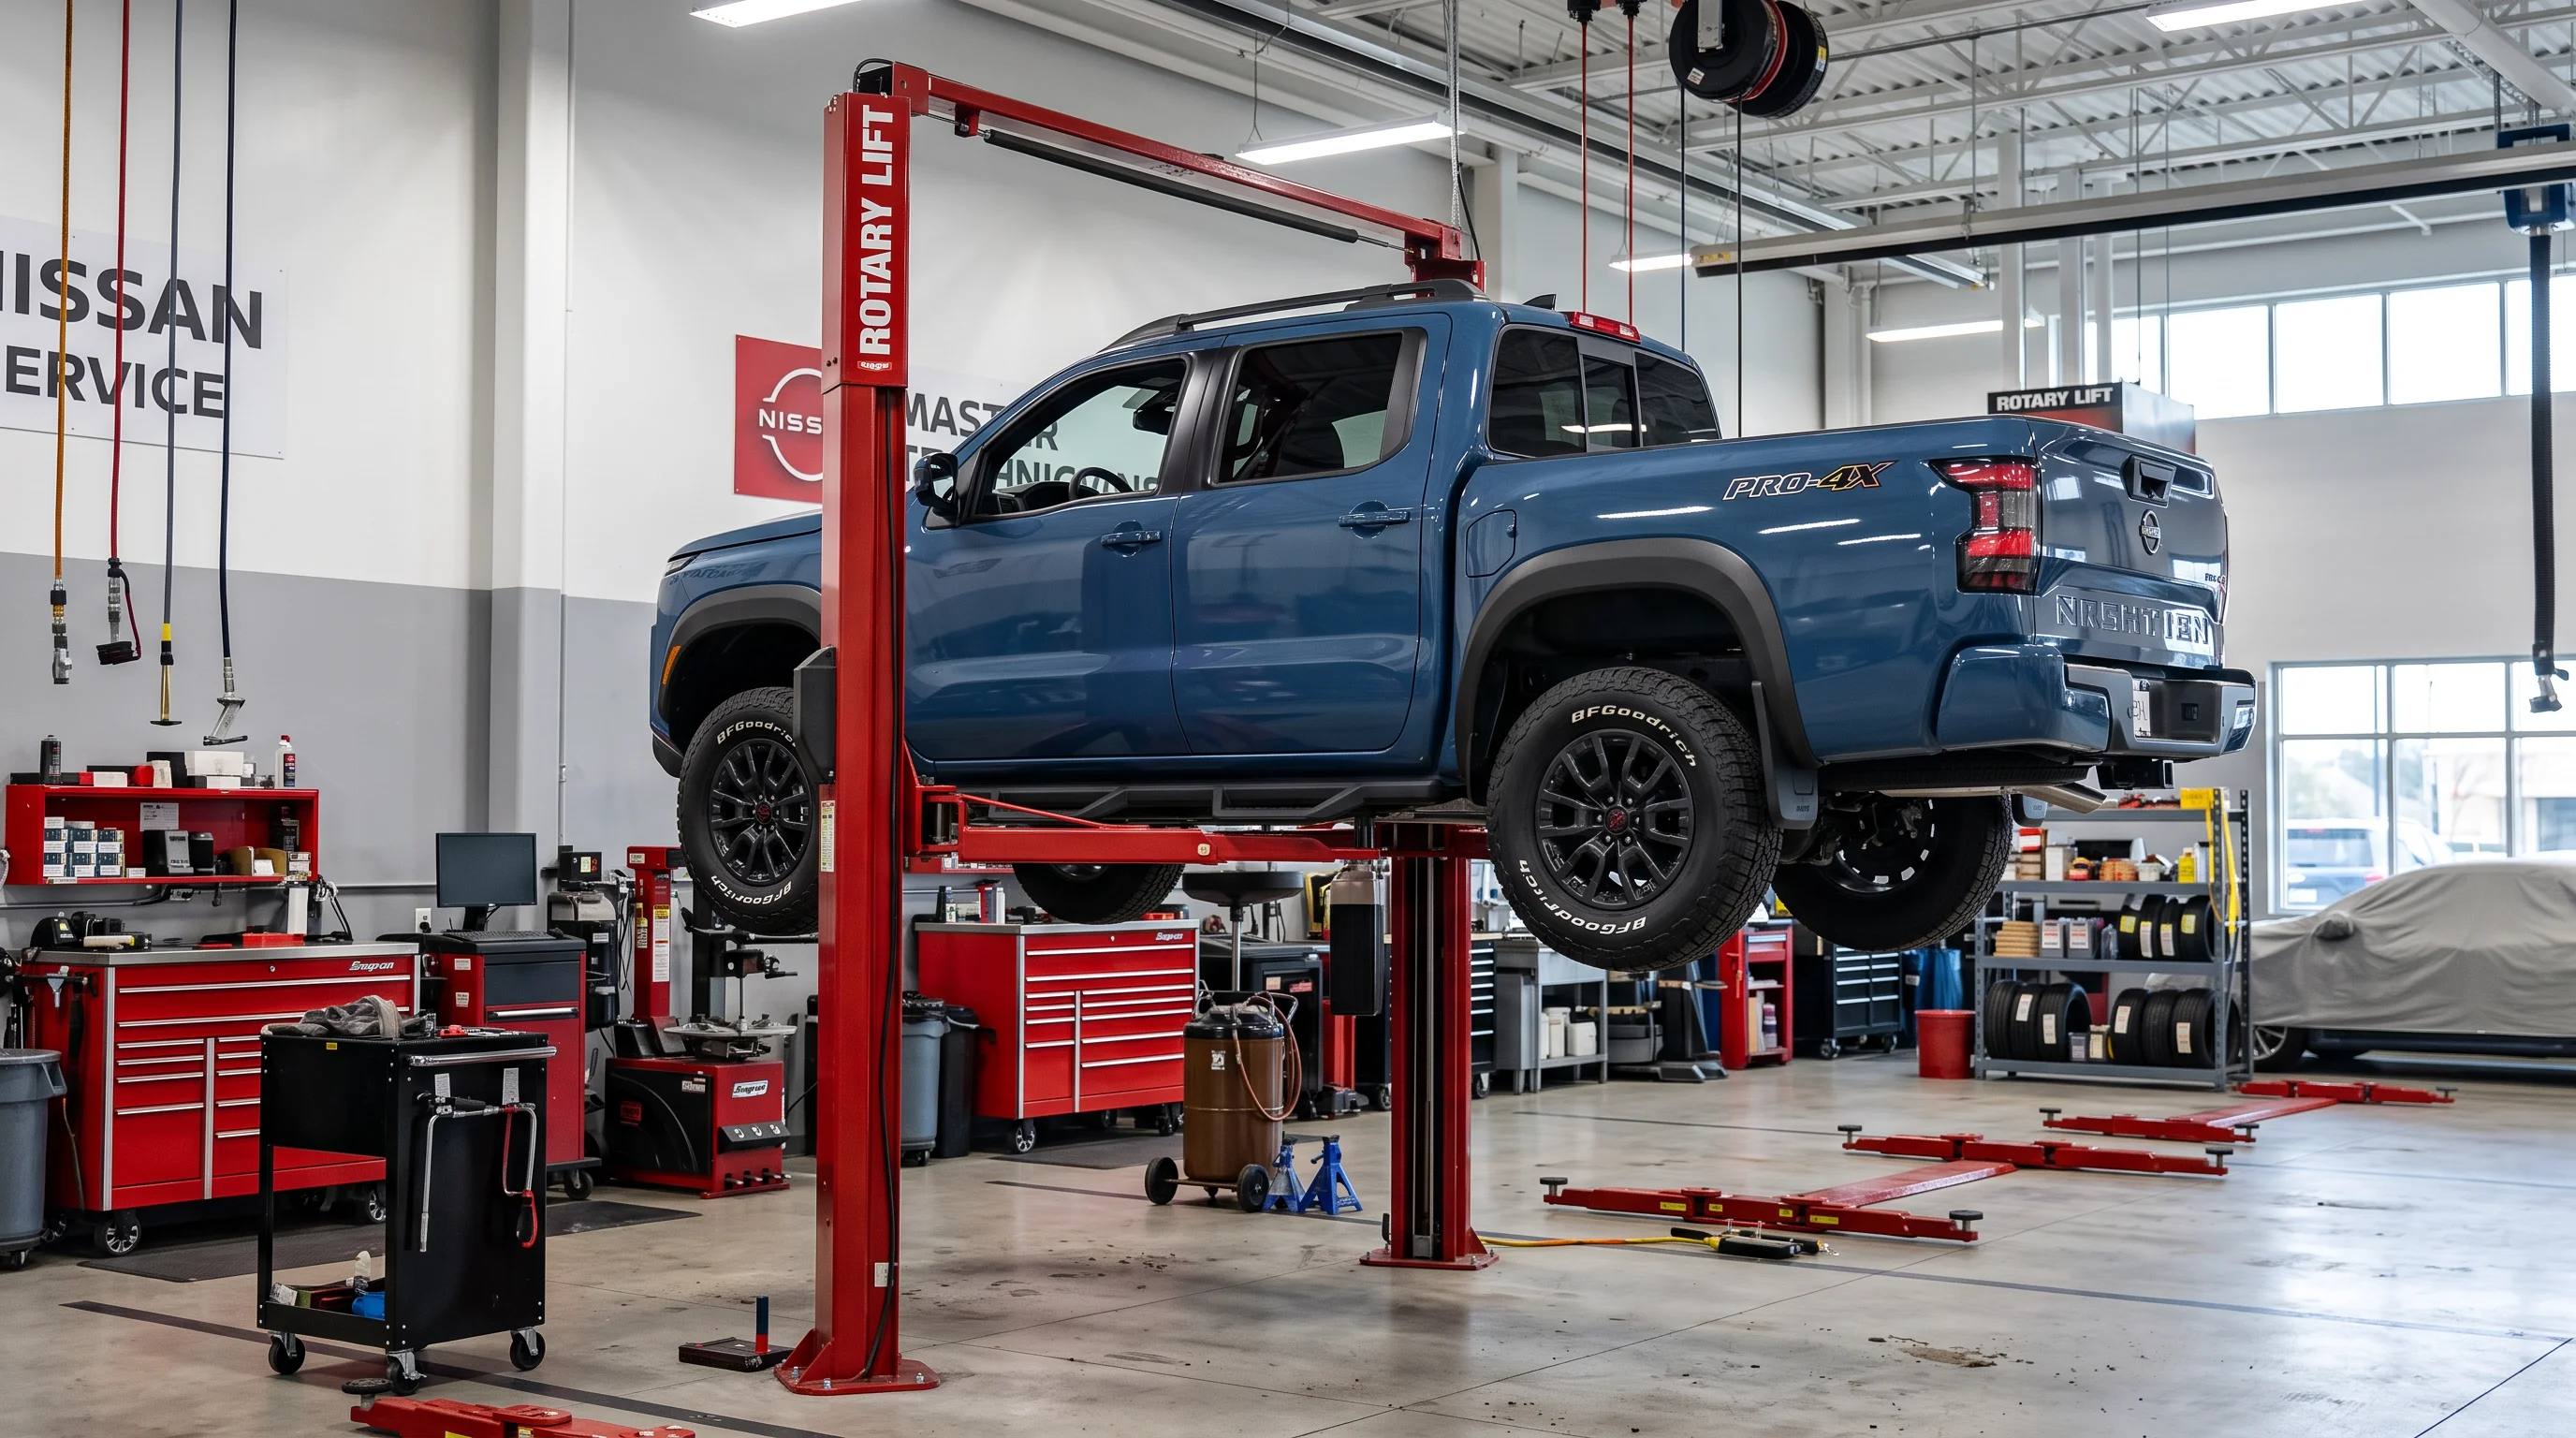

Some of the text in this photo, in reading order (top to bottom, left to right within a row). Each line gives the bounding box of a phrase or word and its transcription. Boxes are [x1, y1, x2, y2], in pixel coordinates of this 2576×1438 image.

[861, 104, 894, 186] LIFT
[0, 250, 263, 350] ISSAN
[859, 198, 892, 356] ROTARY
[6, 345, 225, 419] ERVICE
[1996, 387, 2114, 412] ROTARY LIFT
[758, 408, 823, 435] NISS
[1721, 459, 1901, 501] PRO-4X
